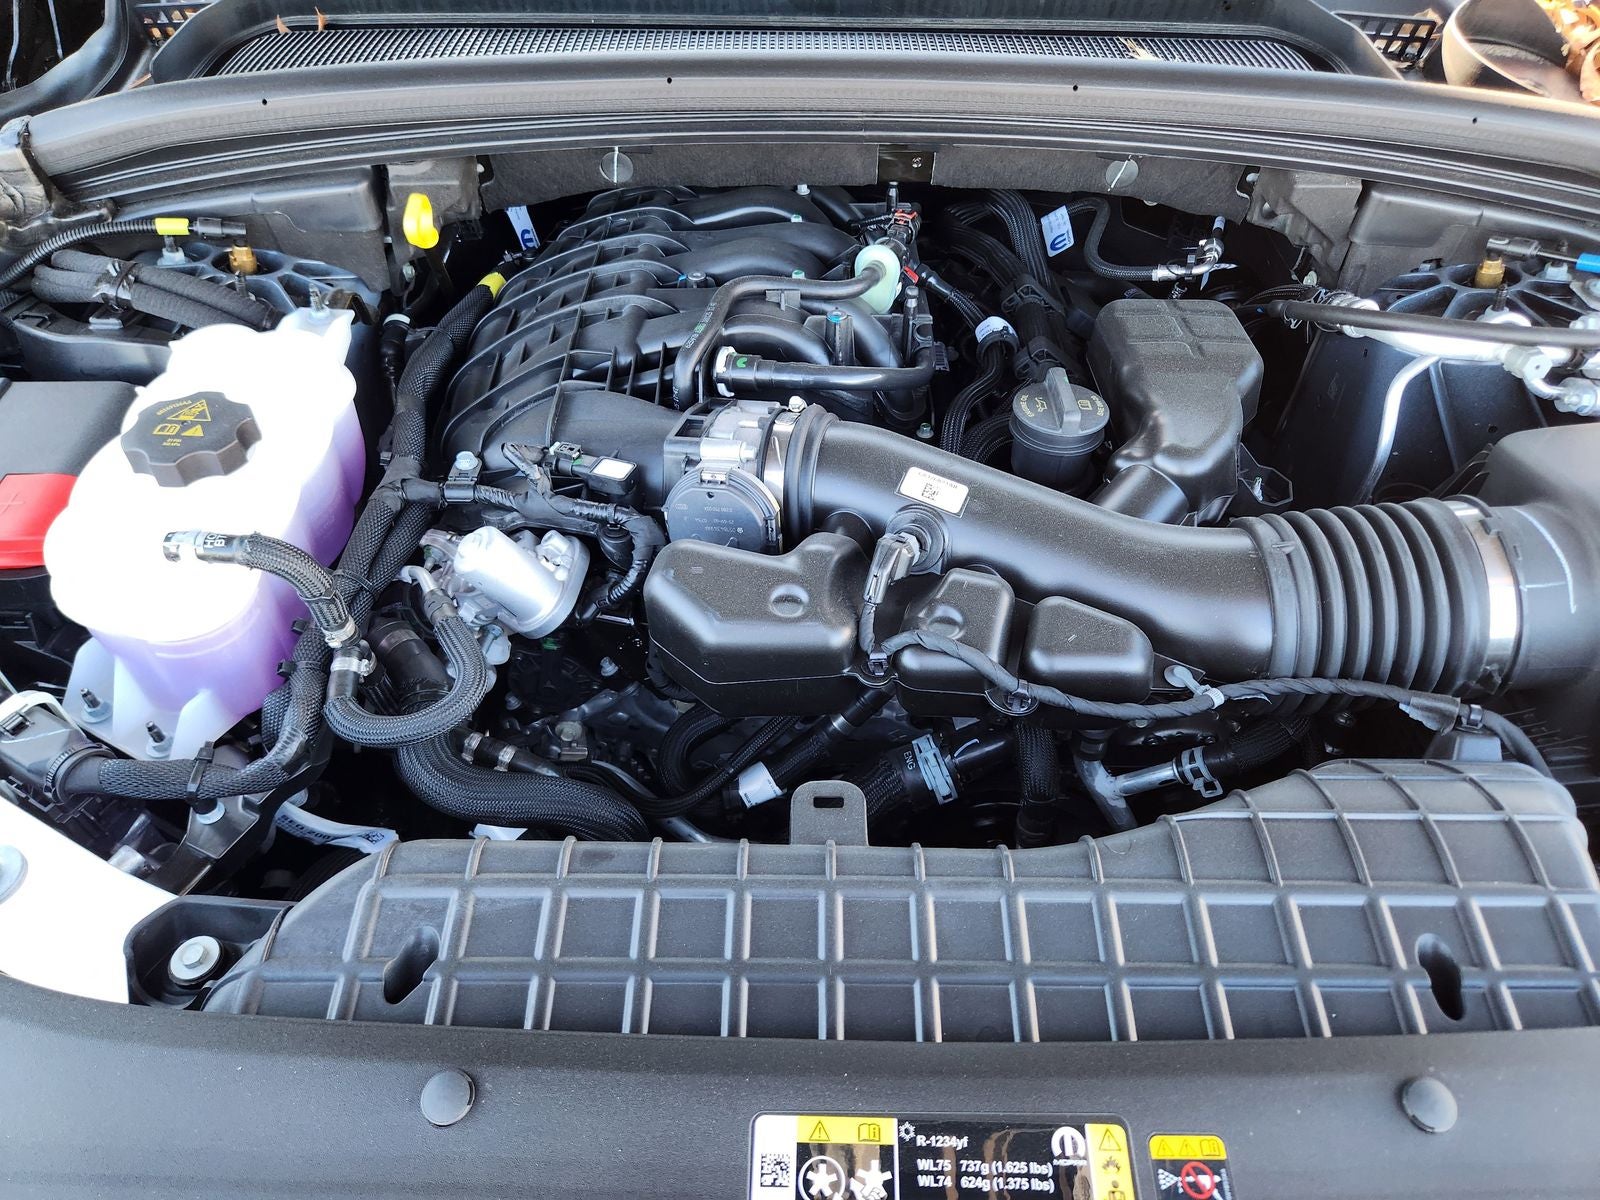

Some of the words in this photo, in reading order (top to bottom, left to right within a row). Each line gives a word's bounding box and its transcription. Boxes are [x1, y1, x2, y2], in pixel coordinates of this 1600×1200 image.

[903, 750, 916, 770] ENG
[915, 1134, 969, 1150] R-1234yf
[916, 1158, 952, 1171] WL75
[959, 1159, 990, 1176] 737g
[991, 1160, 1028, 1176] (1.625
[1028, 1161, 1053, 1178] lbs)
[916, 1174, 953, 1188] WL74
[960, 1175, 991, 1192] 624g
[992, 1176, 1030, 1192] (1.375
[1030, 1177, 1055, 1194] lbs)
